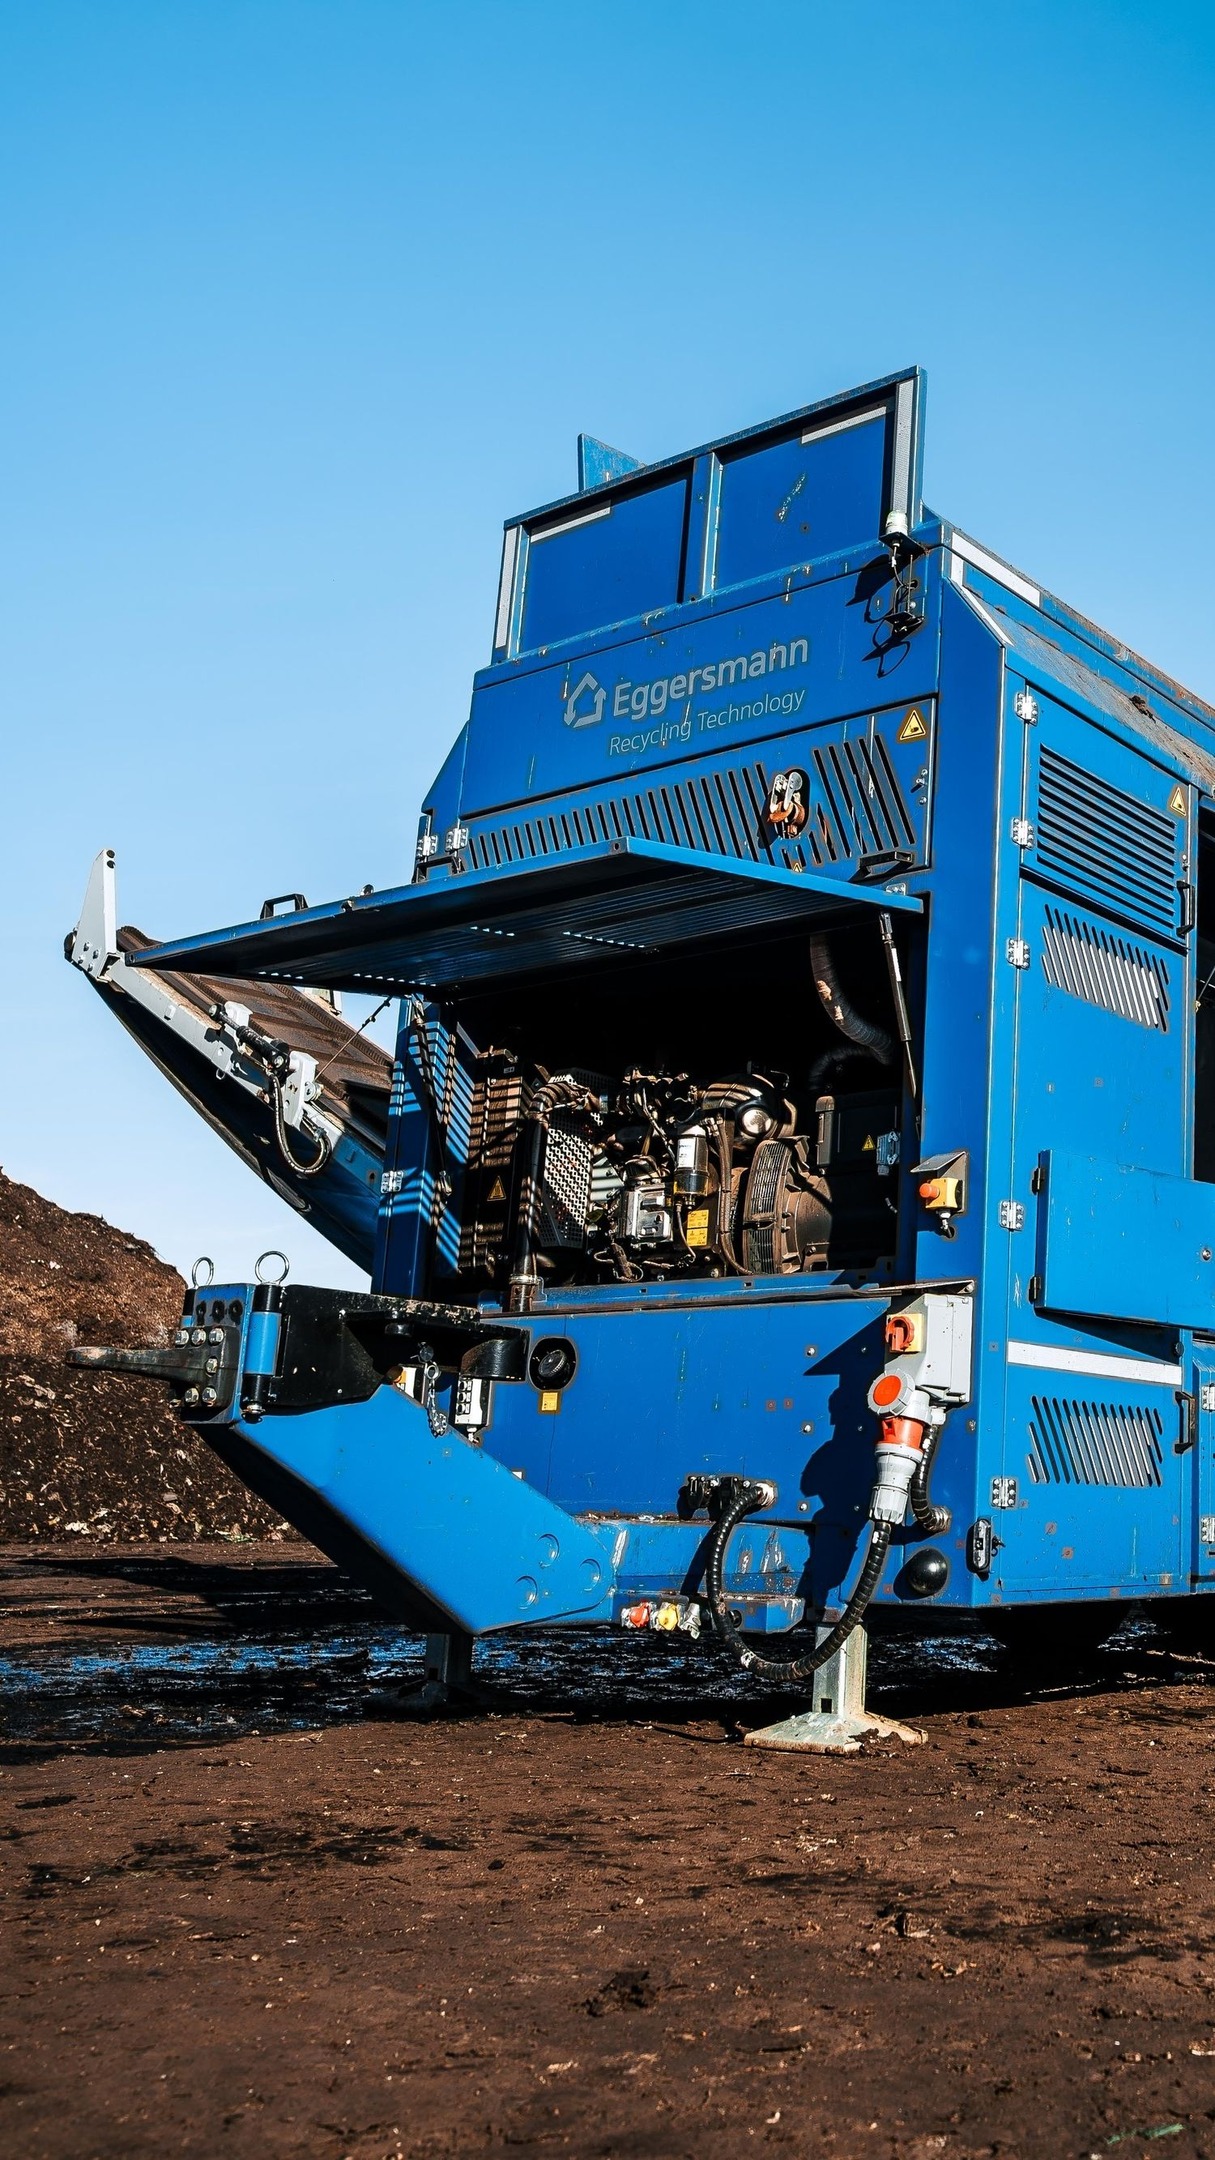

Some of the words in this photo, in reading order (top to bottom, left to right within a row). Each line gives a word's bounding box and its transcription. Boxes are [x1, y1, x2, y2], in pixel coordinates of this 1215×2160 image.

[613, 638, 808, 720] Eggersmann
[609, 720, 692, 755] Recycling
[698, 690, 805, 731] Technology
